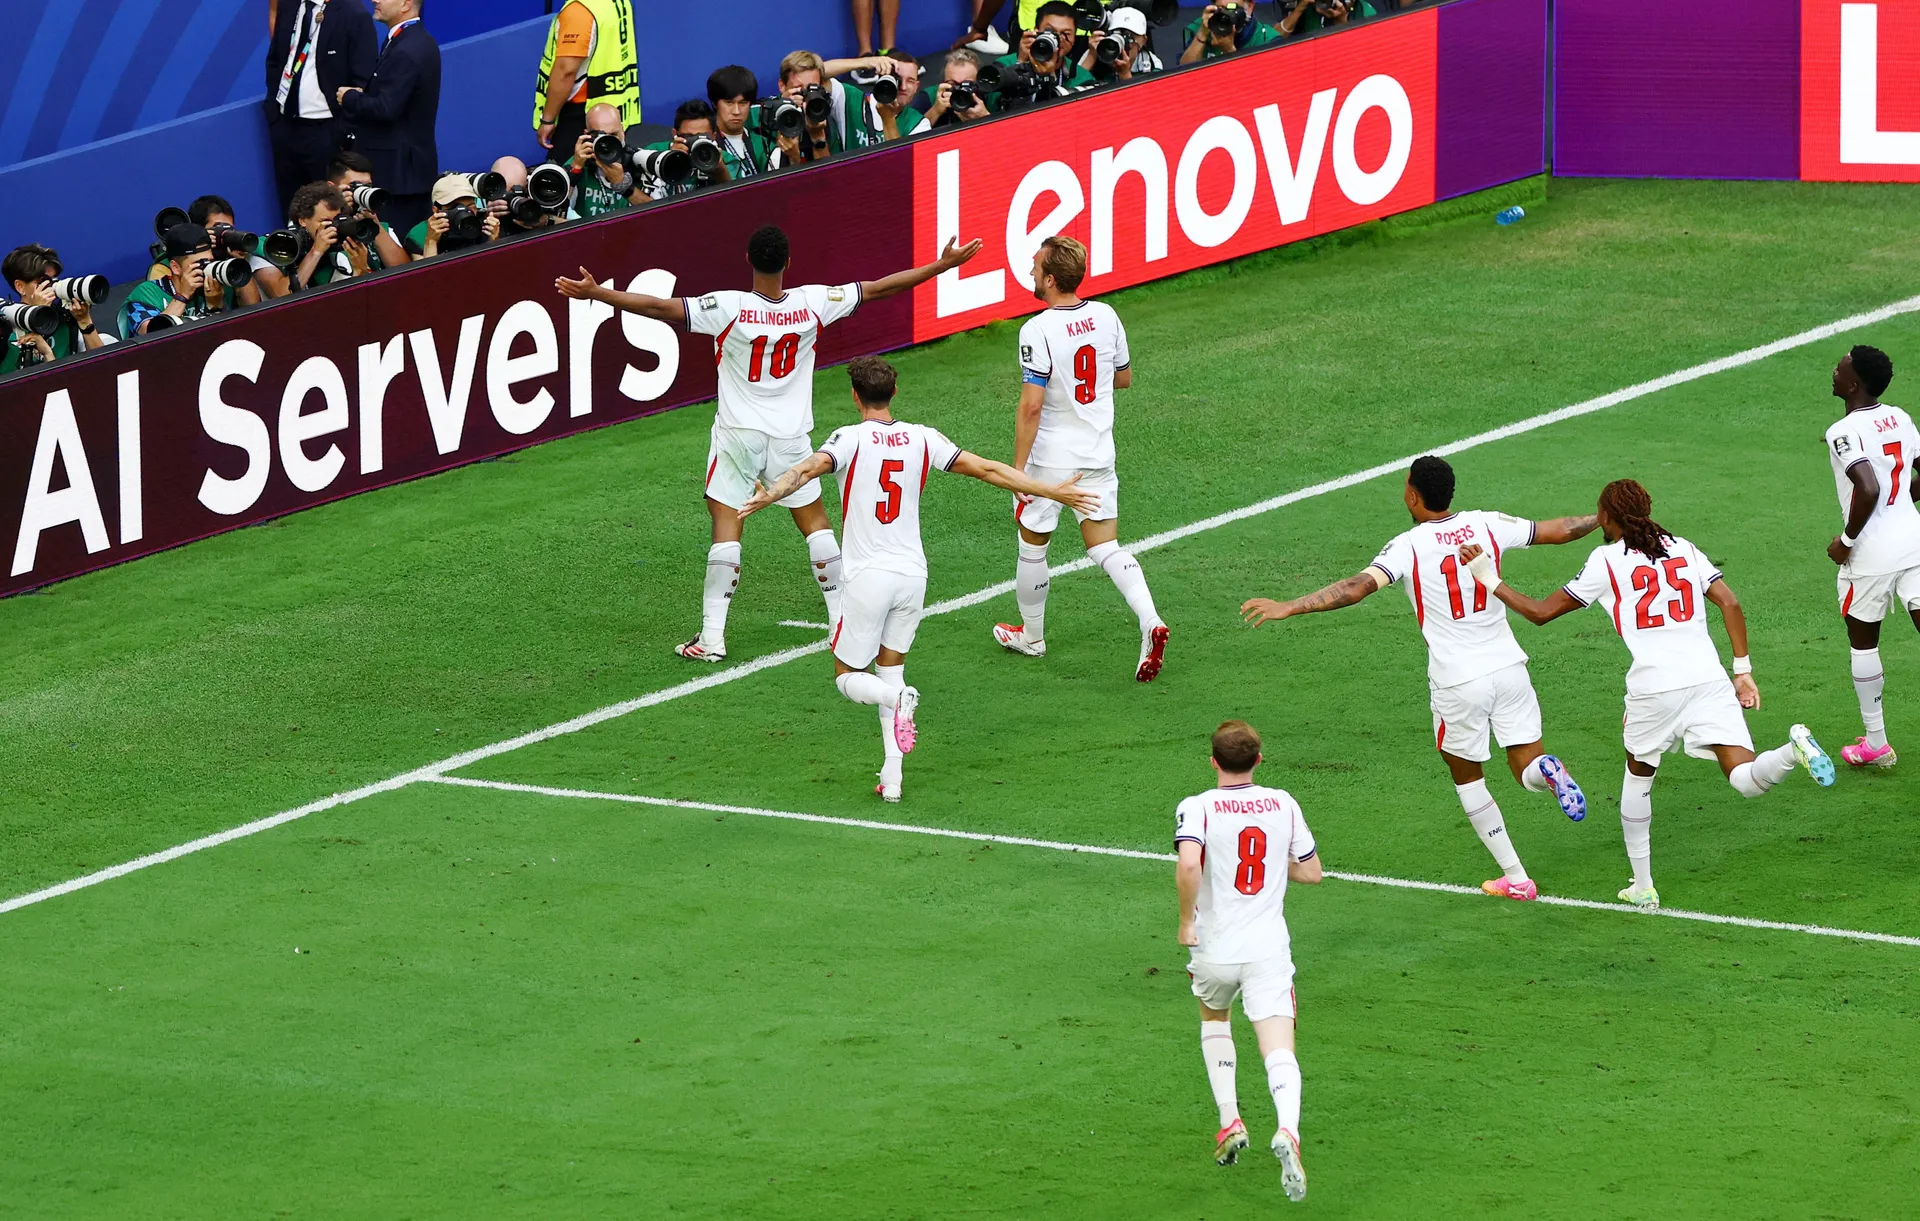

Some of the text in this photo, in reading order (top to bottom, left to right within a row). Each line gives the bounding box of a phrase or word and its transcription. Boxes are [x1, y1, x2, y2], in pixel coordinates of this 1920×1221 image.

[937, 75, 1412, 318] Lenovo
[739, 308, 810, 326] BELLINGHAM
[1066, 317, 1096, 337] KANE
[748, 332, 801, 382] 10
[1074, 344, 1097, 405] 9
[11, 269, 680, 577] AI Servers
[875, 459, 904, 525] 5
[1882, 440, 1904, 506] 7
[1631, 556, 1695, 629] 25
[1214, 797, 1281, 815] ANDERSON
[1488, 826, 1503, 838] ENG
[1234, 826, 1267, 895] 8
